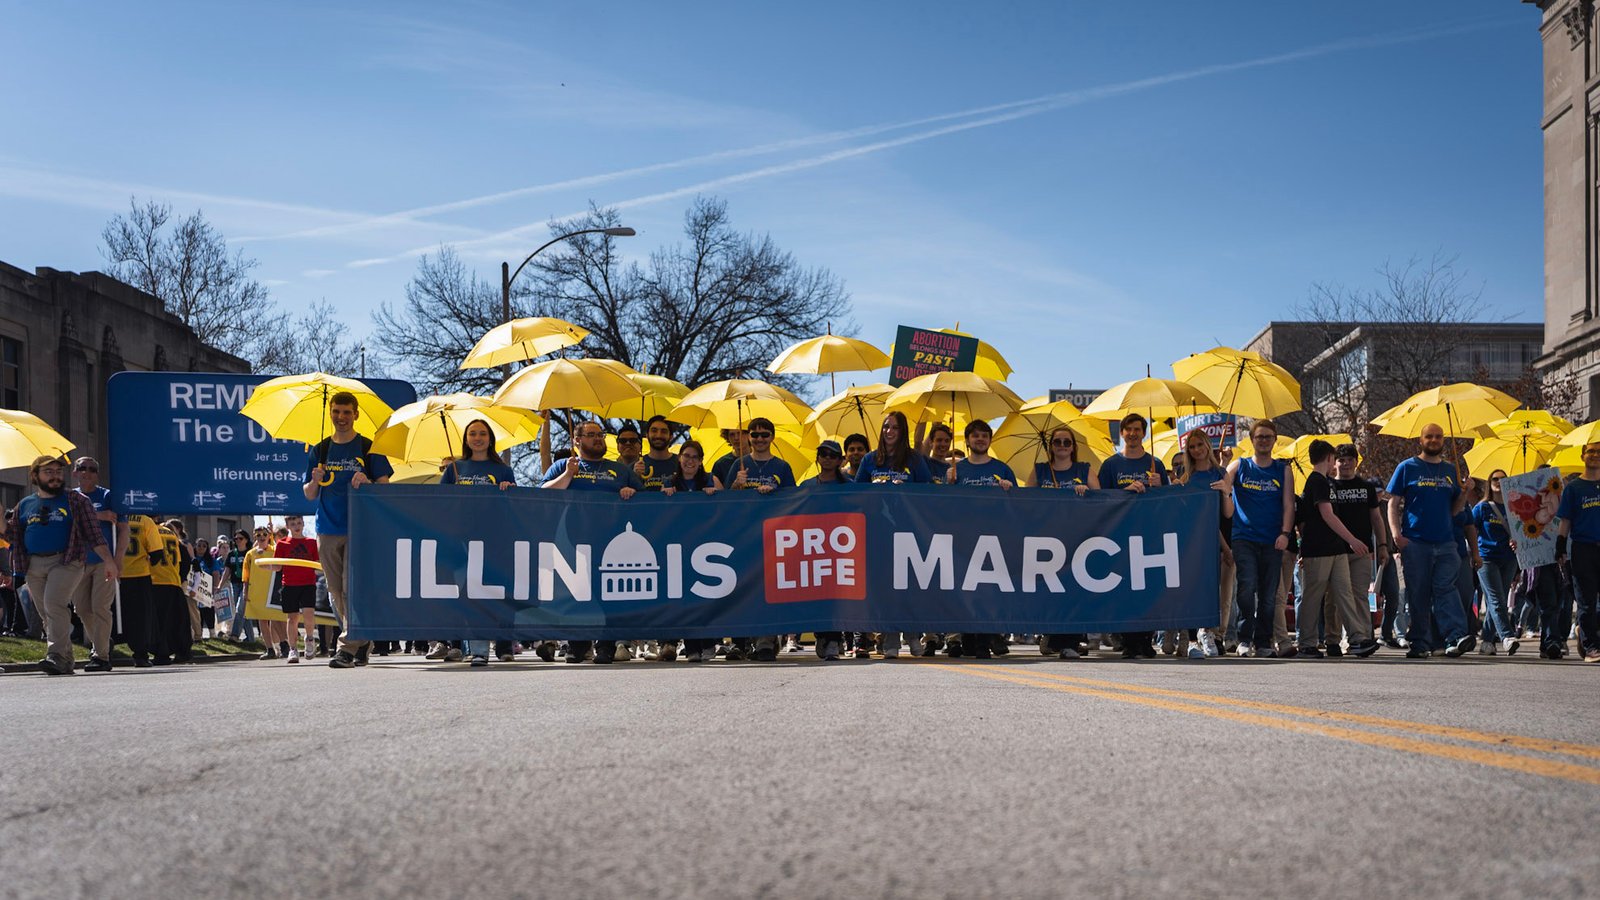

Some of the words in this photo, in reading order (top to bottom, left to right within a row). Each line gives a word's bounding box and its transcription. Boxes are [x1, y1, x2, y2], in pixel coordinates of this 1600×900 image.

[909, 344, 939, 354] BELONGS
[912, 331, 961, 351] ABORTION
[896, 366, 938, 380] CONST
[170, 382, 256, 410] REM
[172, 418, 234, 442] The
[1185, 413, 1222, 431] HURTS
[255, 453, 270, 462] Jer
[272, 453, 289, 462] 1:5
[774, 525, 857, 557] PRO
[776, 558, 857, 589] LIFE
[893, 532, 1181, 593] MARCH
